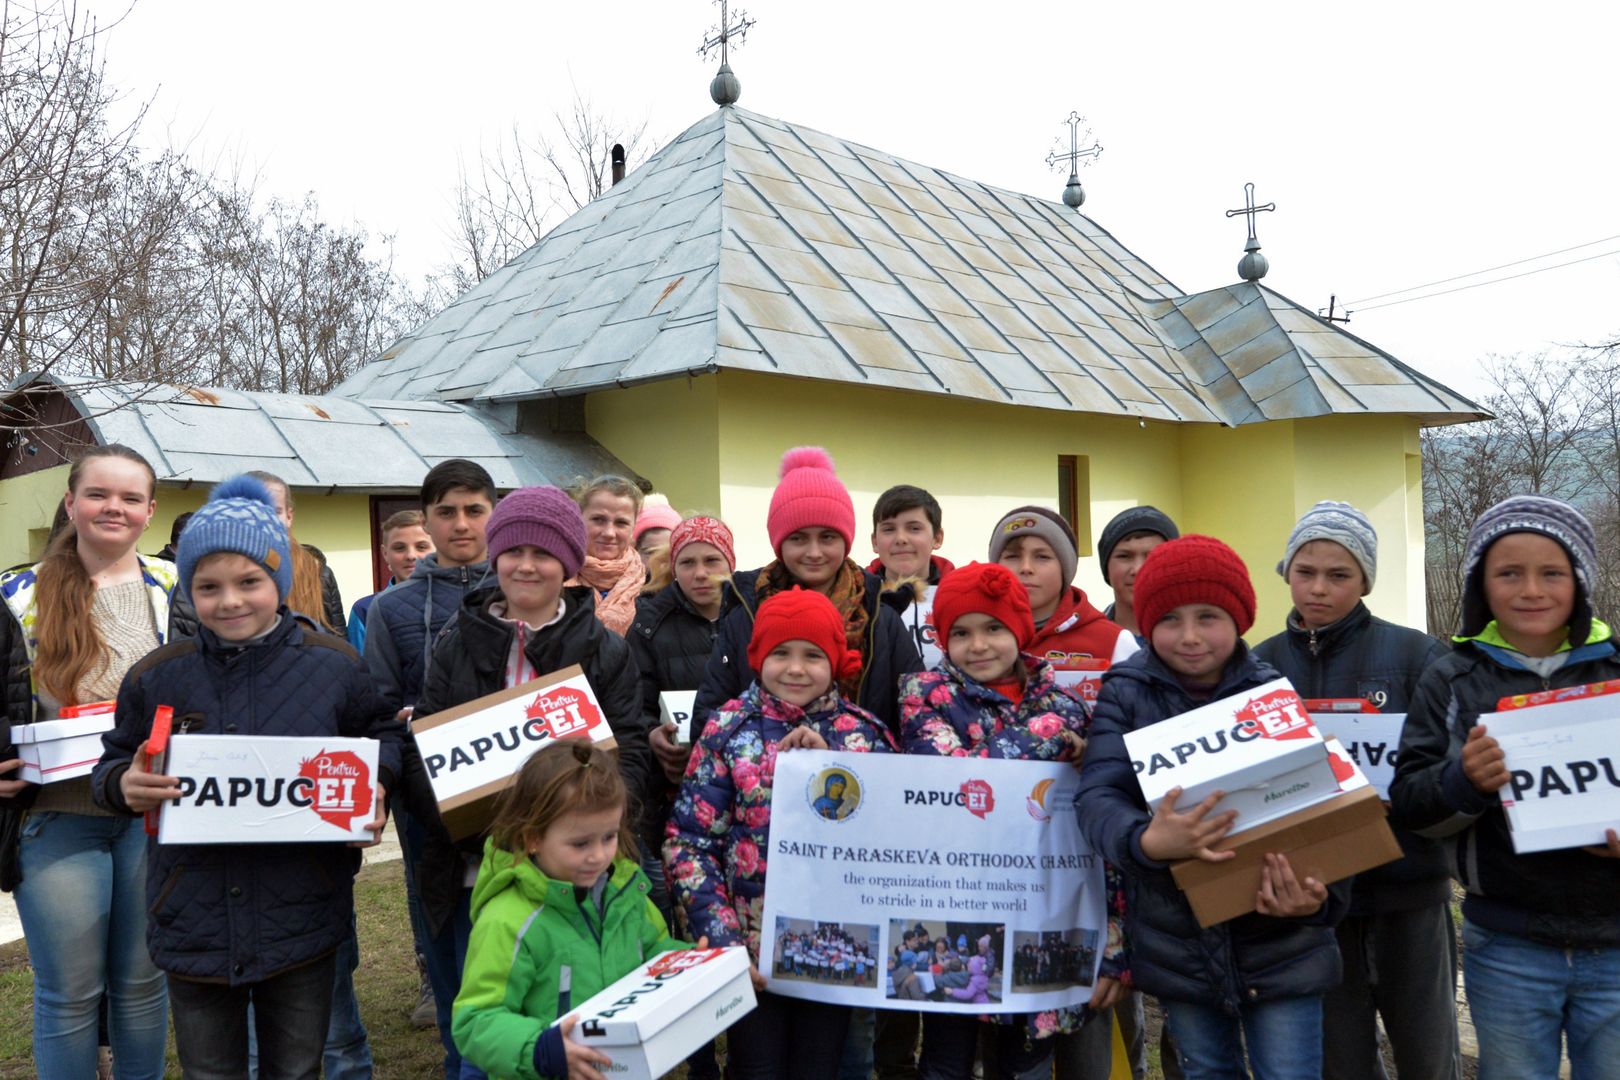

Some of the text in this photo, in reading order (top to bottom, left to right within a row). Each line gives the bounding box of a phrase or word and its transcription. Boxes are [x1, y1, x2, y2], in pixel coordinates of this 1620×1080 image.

[538, 694, 579, 712] Pentru
[1250, 695, 1298, 715] Pentru
[318, 756, 360, 776] Pentru
[778, 840, 1096, 870] SAINT PARASKEVA ORTHODOX CHARITY
[844, 872, 1045, 893] the organization that makes us
[861, 894, 1027, 912] to stride in a better world
